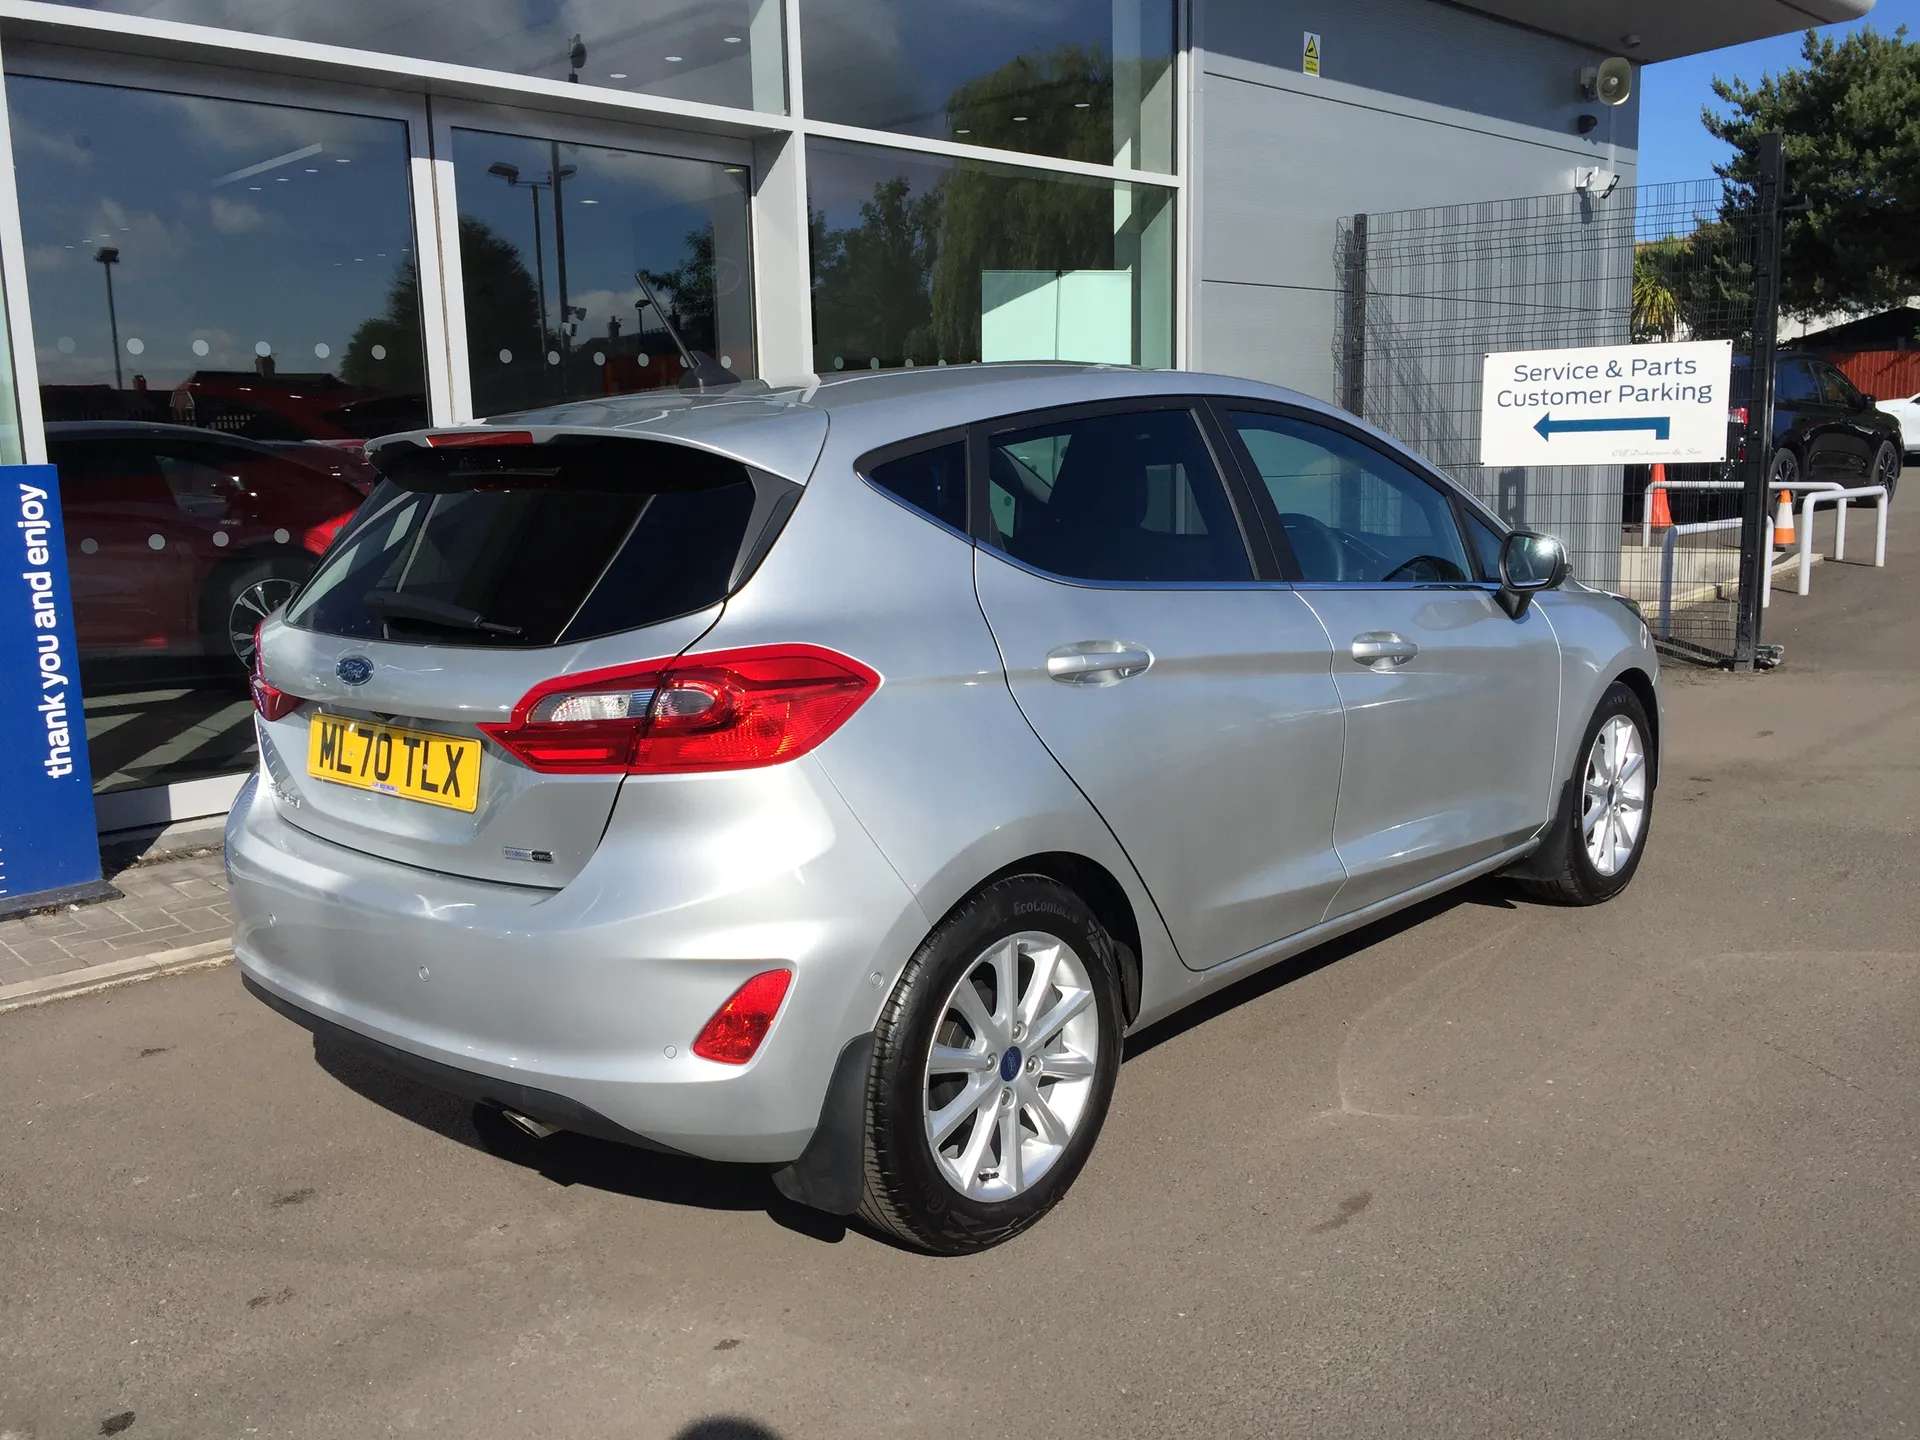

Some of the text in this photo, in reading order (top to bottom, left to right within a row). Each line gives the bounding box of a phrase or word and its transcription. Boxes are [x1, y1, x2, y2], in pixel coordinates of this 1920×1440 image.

[1497, 382, 1712, 407] Customer Parking
[1514, 357, 1697, 382] Service & Parts
[17, 483, 73, 779] thank you and enjoy
[319, 721, 465, 798] ML70 TLX
